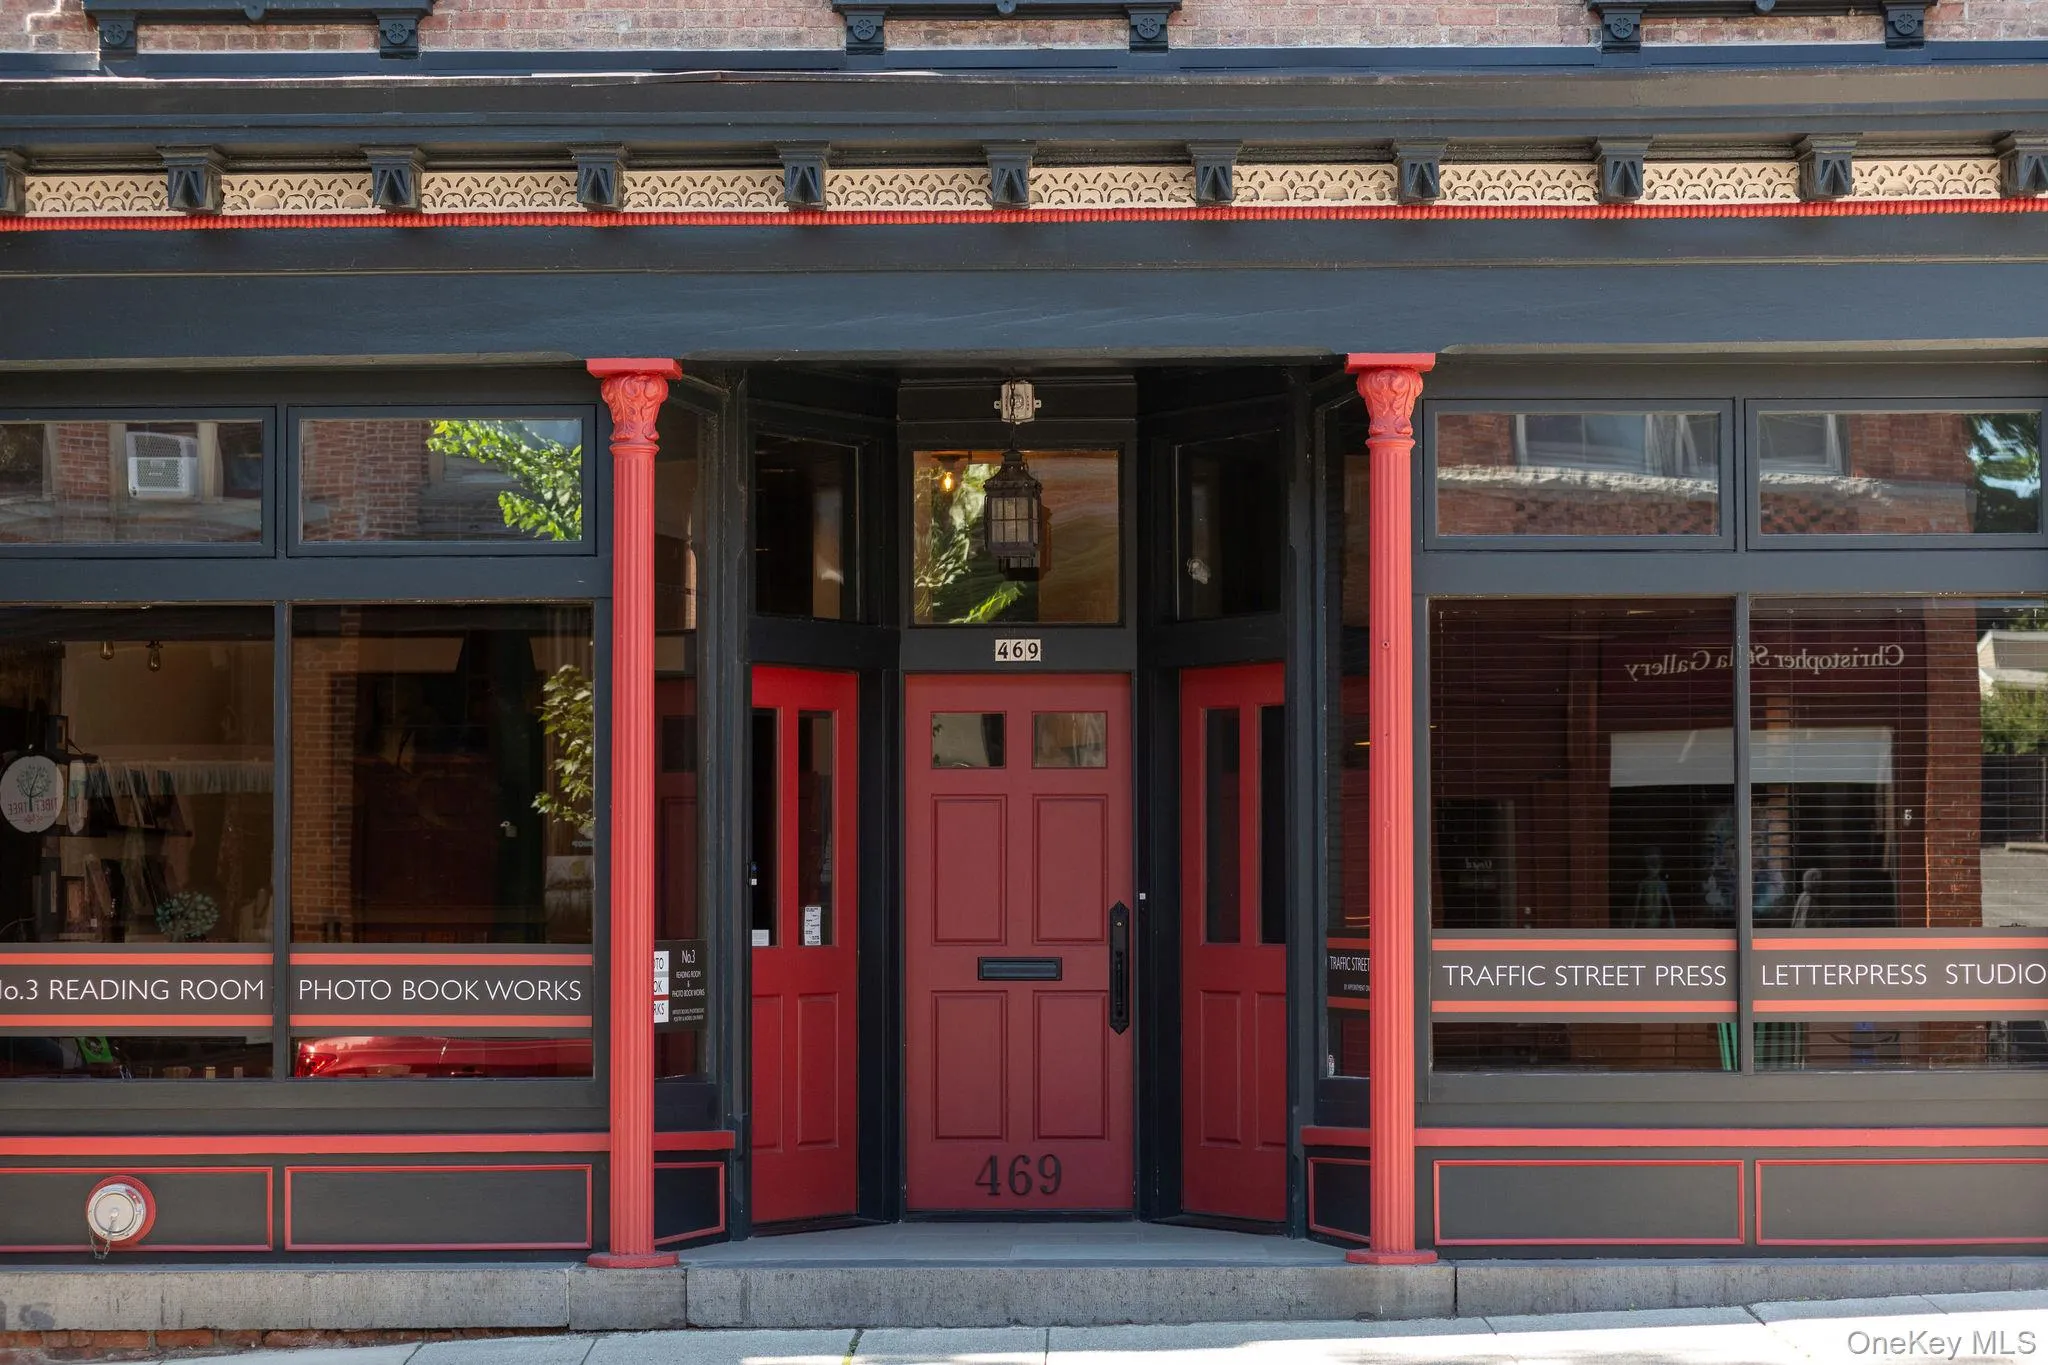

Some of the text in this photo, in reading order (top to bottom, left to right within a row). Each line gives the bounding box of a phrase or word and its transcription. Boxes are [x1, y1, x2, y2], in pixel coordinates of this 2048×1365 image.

[997, 641, 1039, 660] 469
[1329, 955, 1370, 972] TRAFFIC STREET
[1762, 963, 2047, 986] LETTERPRESS STUDIO
[1442, 965, 1727, 987] TRAFFIC STREET PRESS
[0, 979, 264, 1001] o.3 READING ROOM
[299, 979, 582, 1001] PHOTO BOOK WORKS
[974, 1153, 1062, 1197] 469
